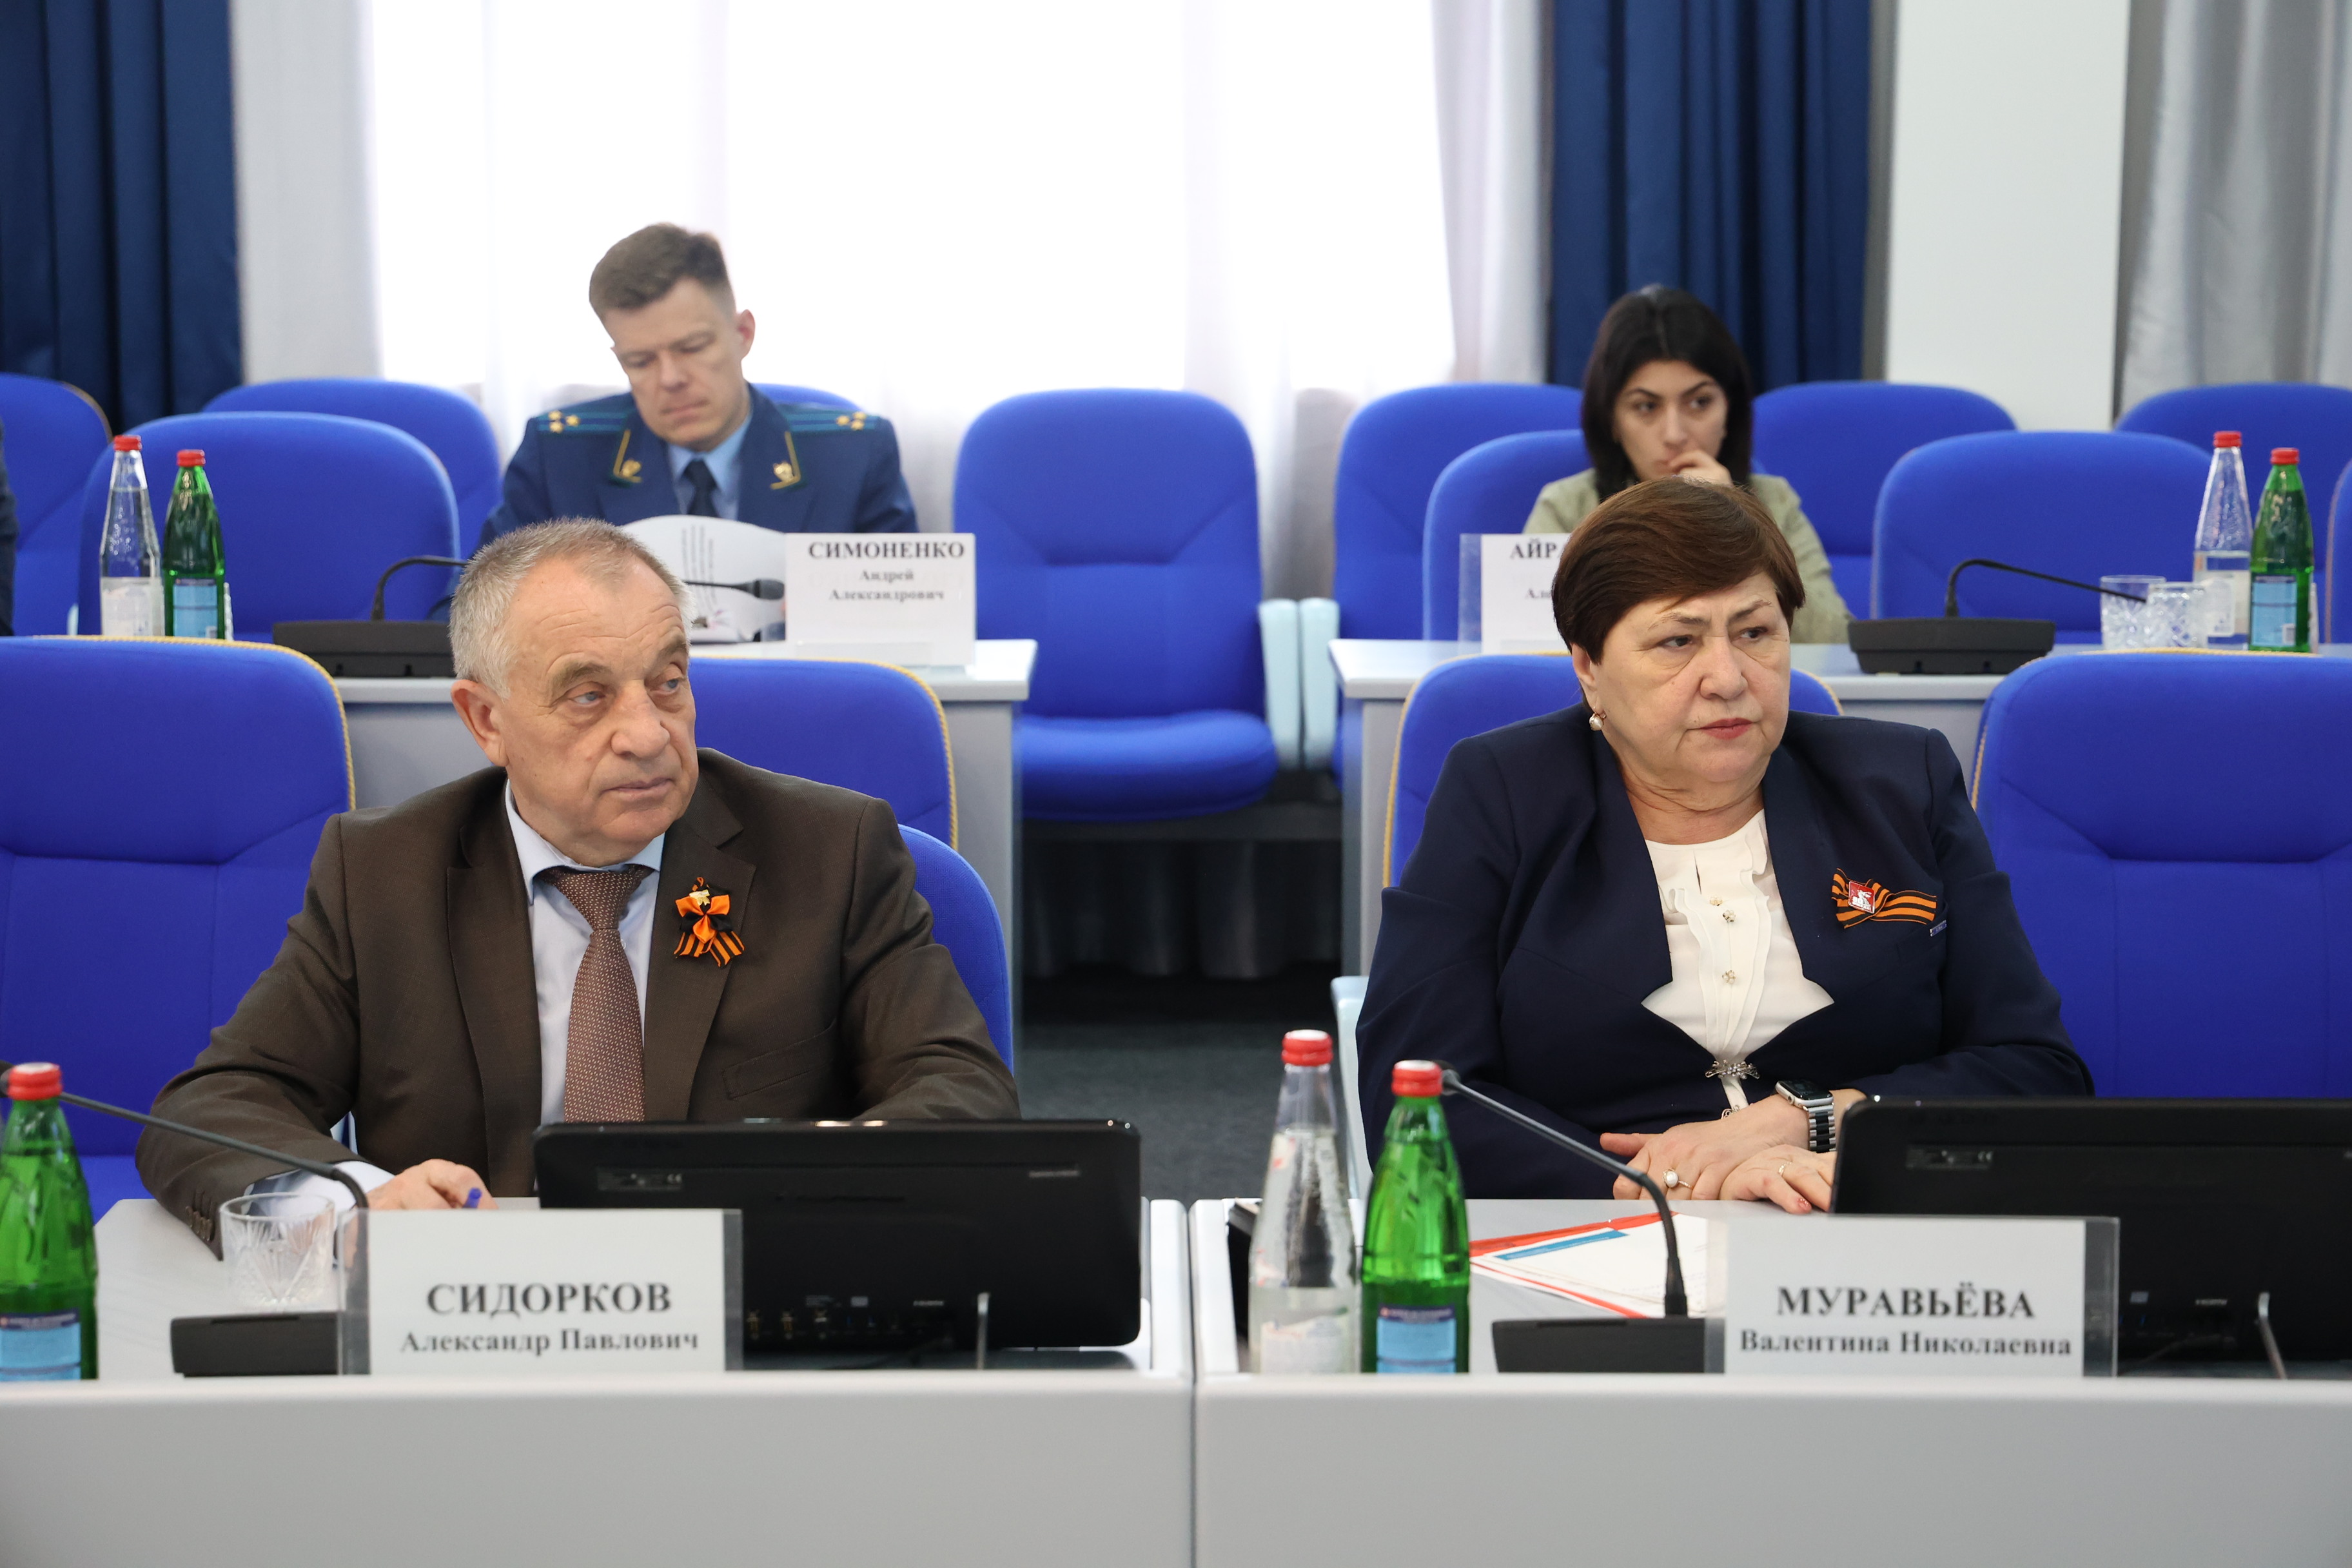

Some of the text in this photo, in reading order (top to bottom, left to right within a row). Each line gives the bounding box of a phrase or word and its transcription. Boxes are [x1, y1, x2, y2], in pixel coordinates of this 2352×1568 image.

[808, 542, 965, 559] СИМОНЕНКО
[1510, 537, 1560, 559] АЙР
[861, 568, 915, 583] Андрей
[830, 589, 945, 603] Александрович
[426, 1282, 672, 1320] СИДОРКОВ
[1776, 1281, 2036, 1318] МУРАВЬЁВА
[400, 1328, 700, 1358] Александр Павлович
[1740, 1329, 2073, 1357] Валентина Николаевна
